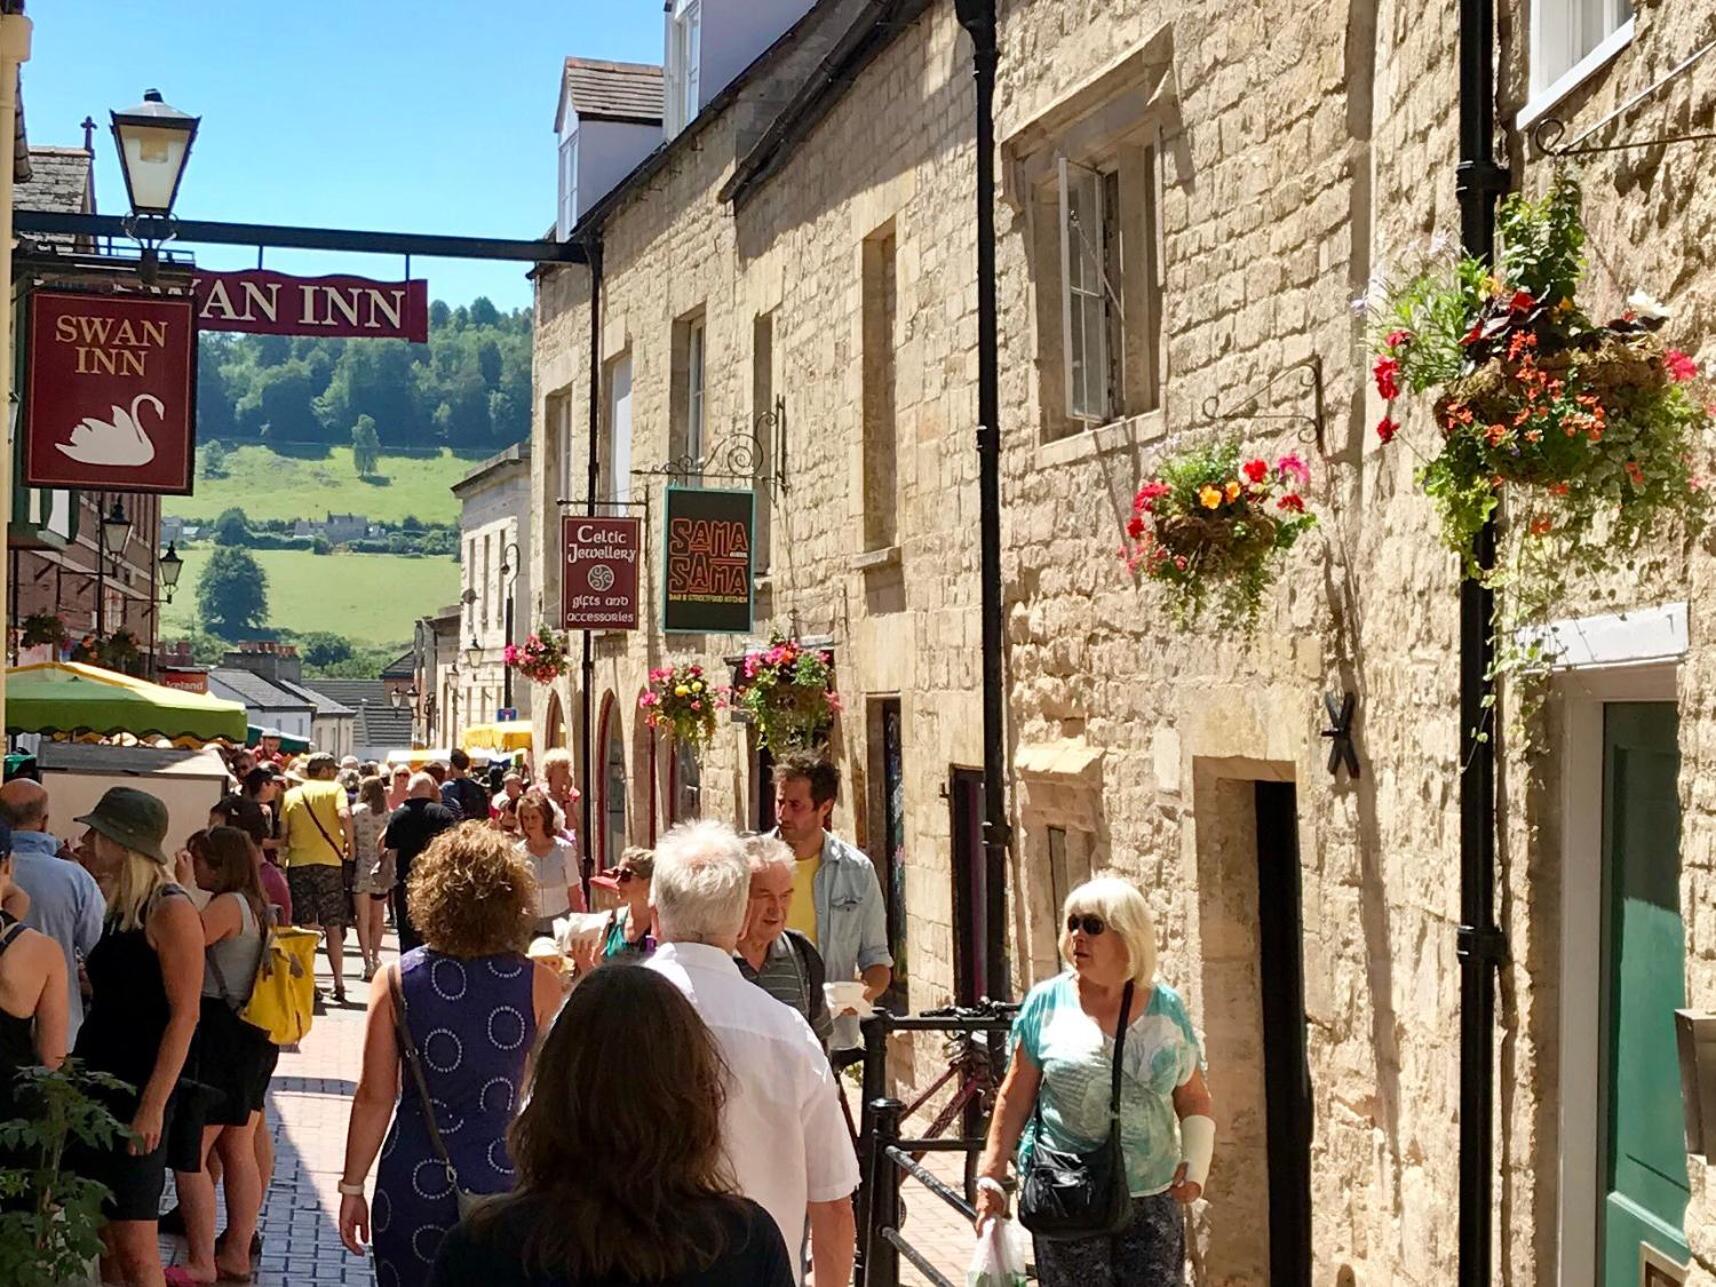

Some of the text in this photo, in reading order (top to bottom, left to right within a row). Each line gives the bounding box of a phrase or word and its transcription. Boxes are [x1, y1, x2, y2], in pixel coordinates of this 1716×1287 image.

[298, 284, 405, 329] INN
[56, 315, 168, 348] SWAN
[75, 347, 148, 377] INN
[577, 525, 627, 544] Celtic
[669, 517, 748, 557] SAMA
[567, 543, 637, 563] Jewellery
[669, 553, 748, 595] SAMA
[572, 594, 629, 609] gifts and
[566, 611, 634, 623] accessories
